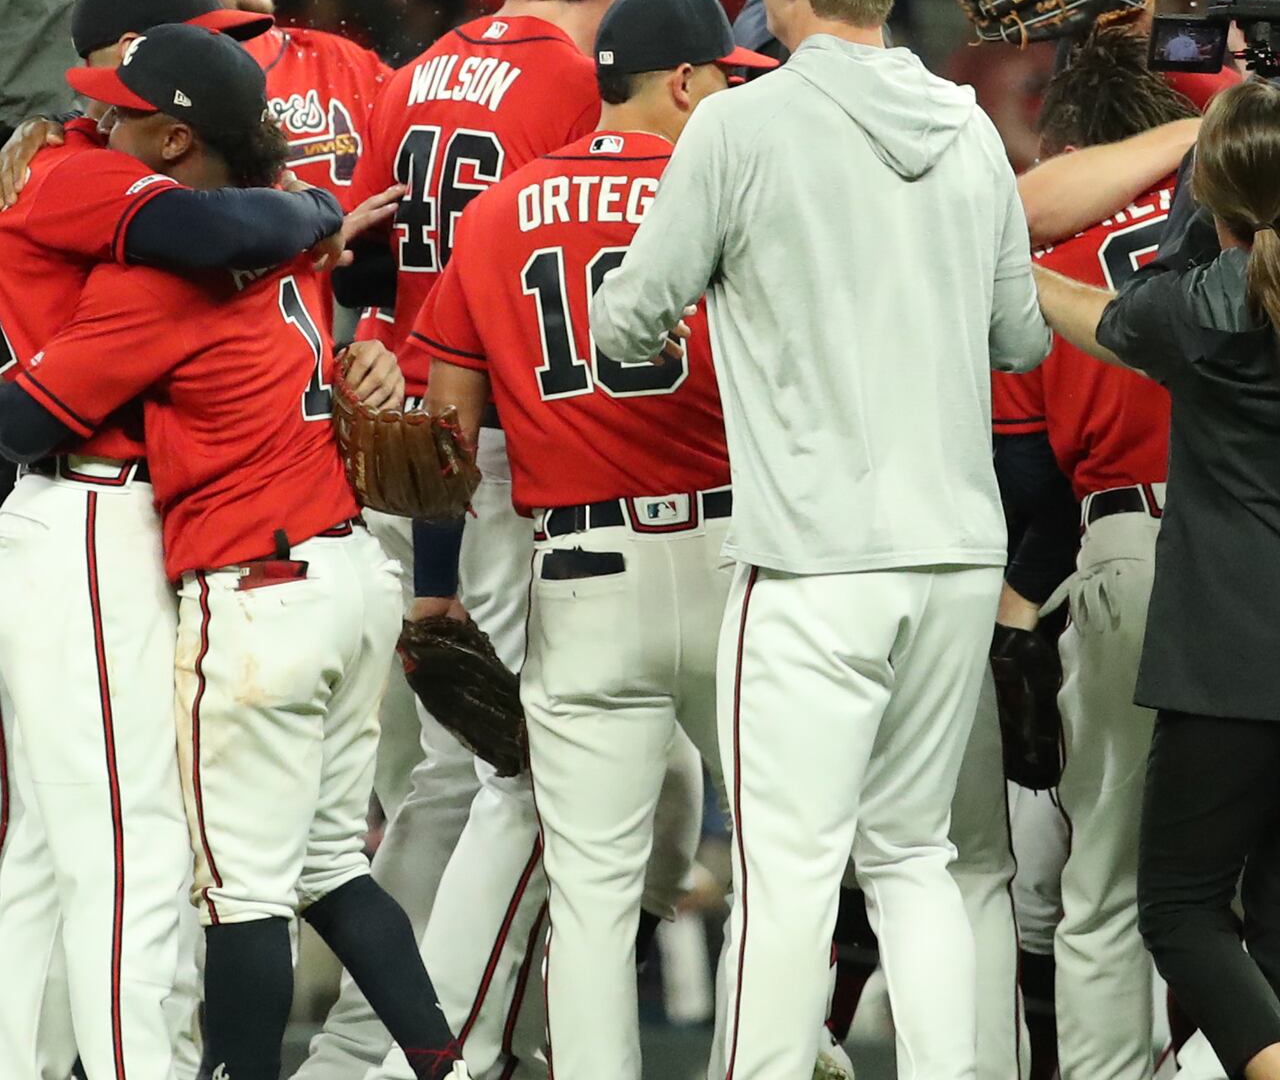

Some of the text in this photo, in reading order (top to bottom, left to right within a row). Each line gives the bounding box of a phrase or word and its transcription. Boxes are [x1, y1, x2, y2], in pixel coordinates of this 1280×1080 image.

[407, 54, 521, 112] WILSON
[393, 125, 505, 273] 46
[517, 175, 659, 233] ORTEG
[278, 275, 333, 421] 1
